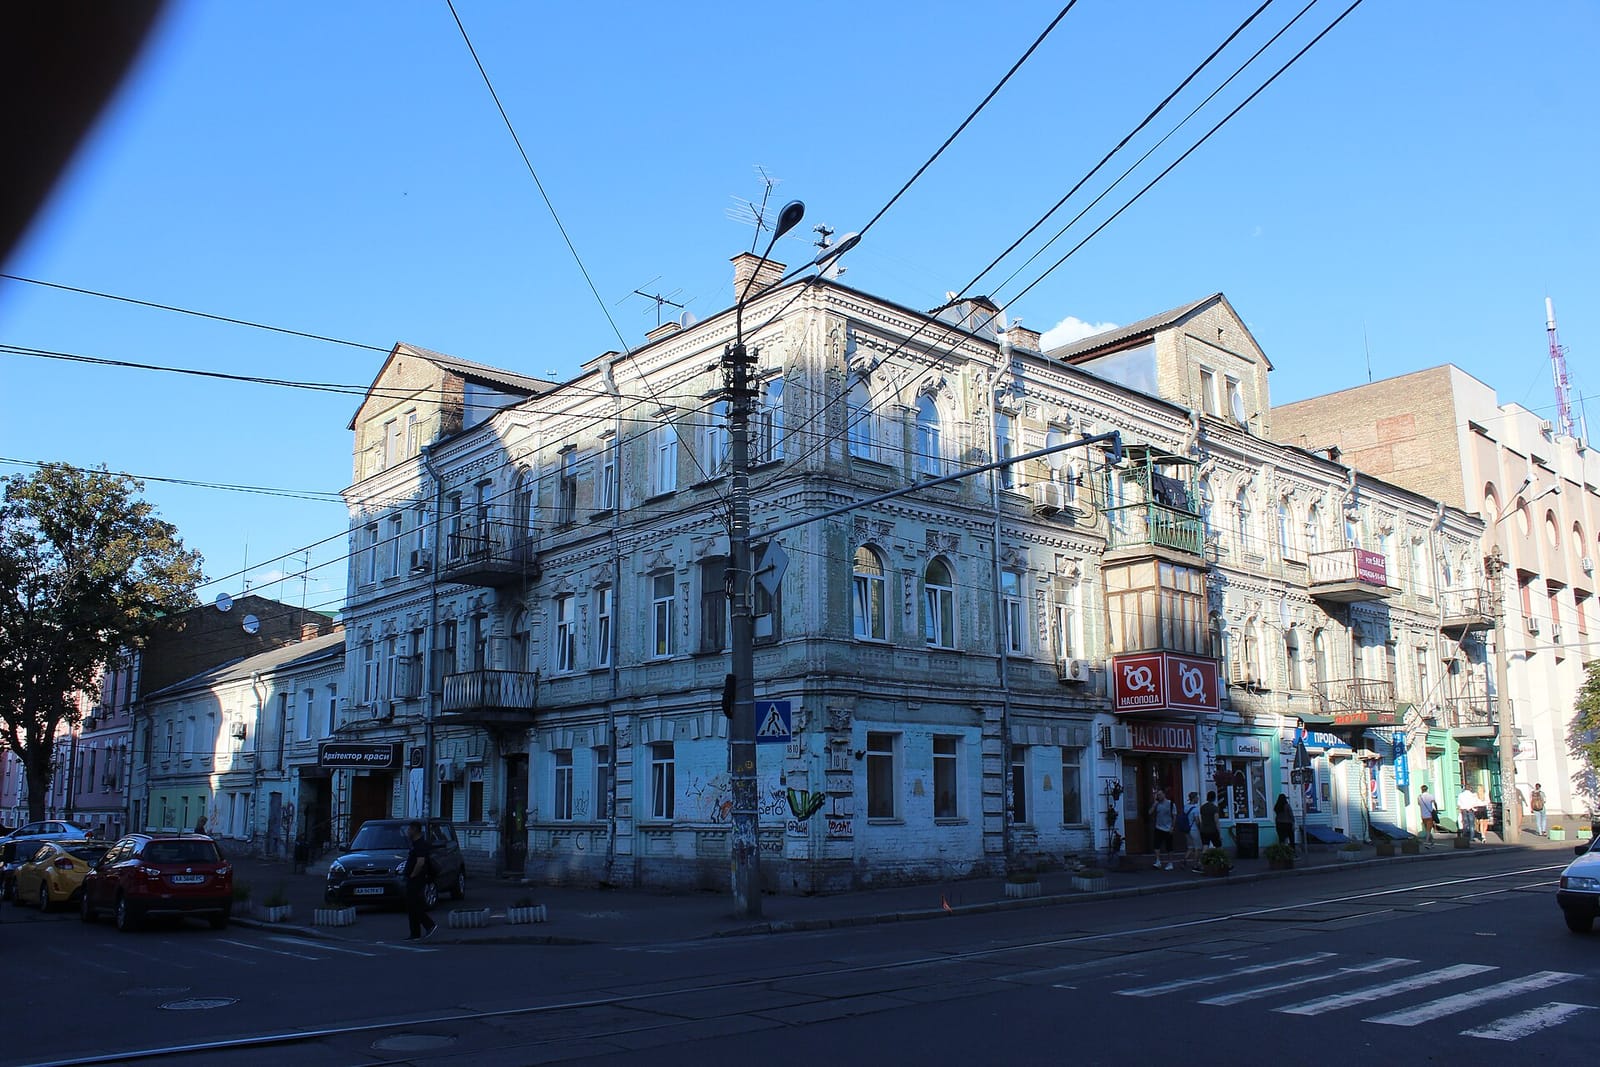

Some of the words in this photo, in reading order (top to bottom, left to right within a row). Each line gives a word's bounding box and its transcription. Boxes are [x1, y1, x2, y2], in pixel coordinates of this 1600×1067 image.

[1372, 556, 1385, 568] SALE
[323, 752, 362, 761] Архітектор
[363, 753, 390, 761] краси
